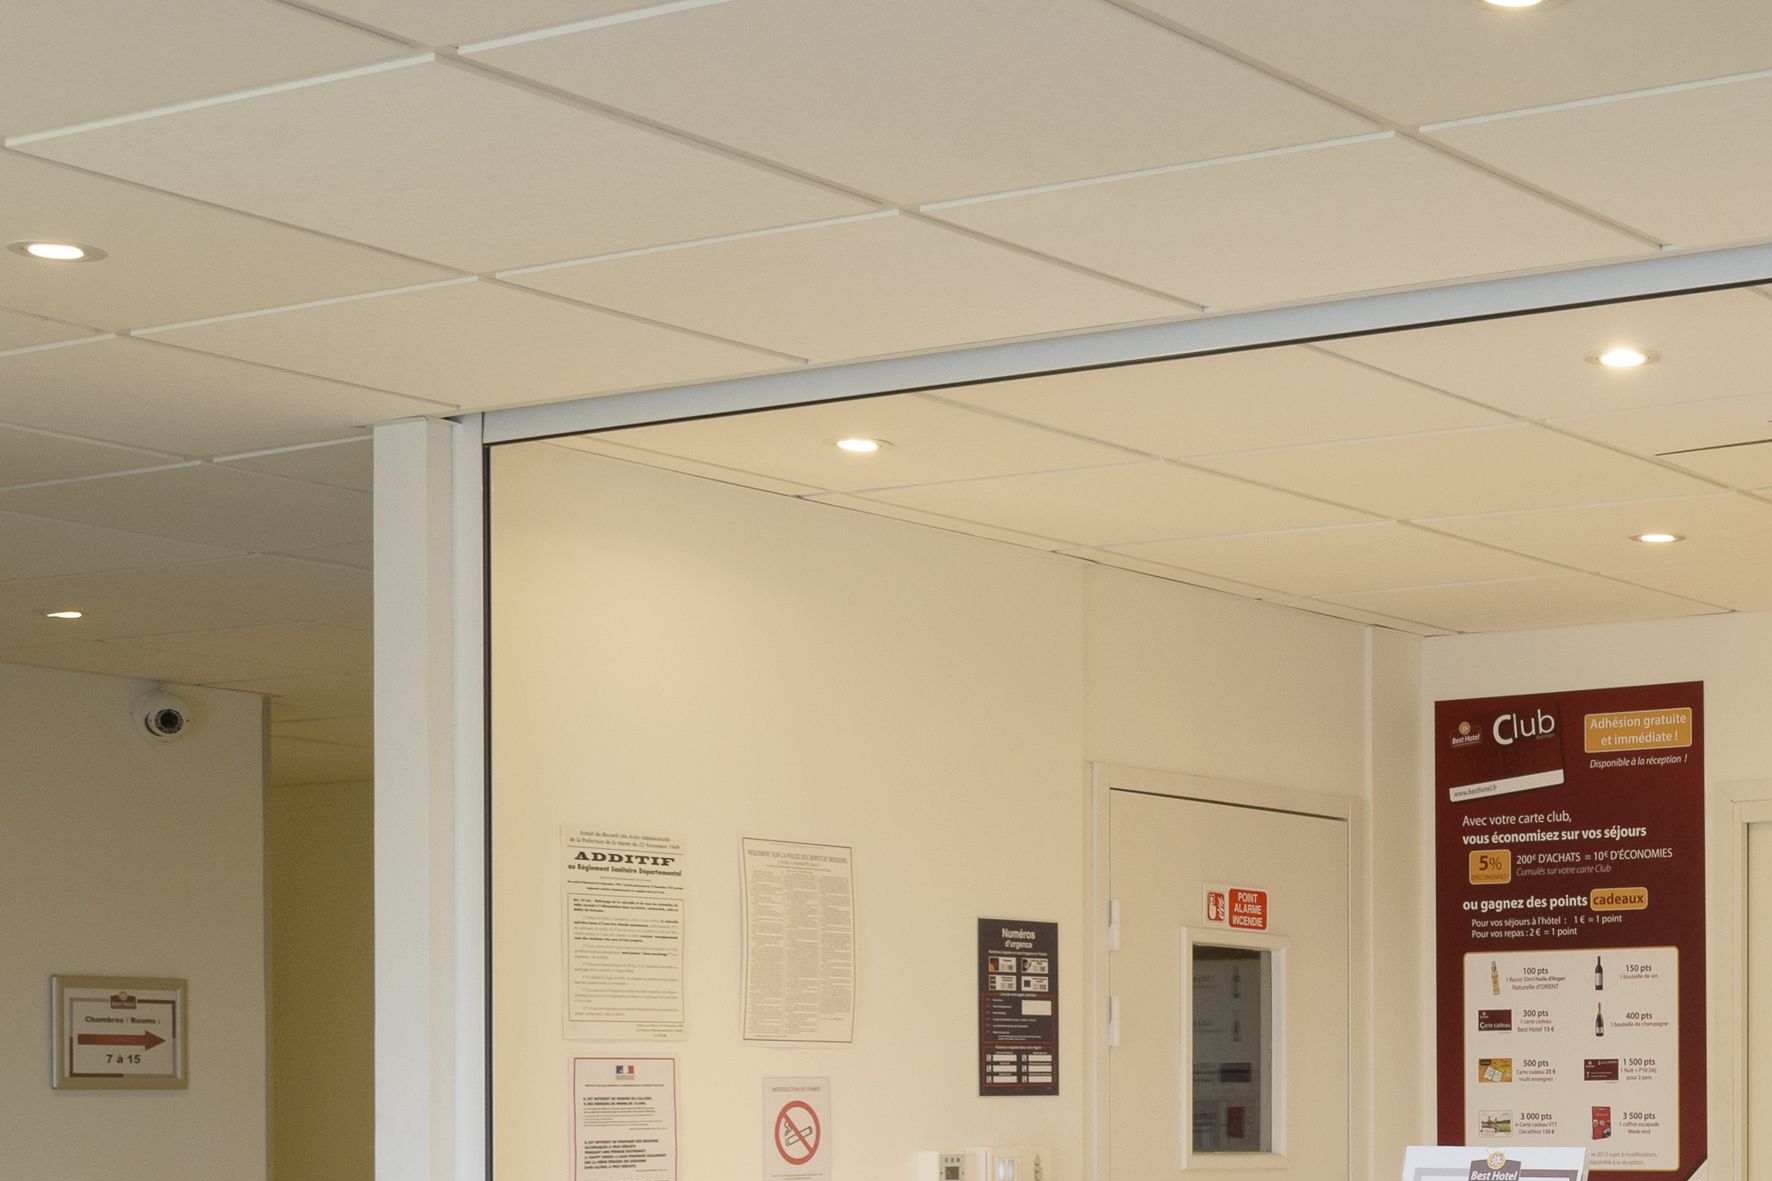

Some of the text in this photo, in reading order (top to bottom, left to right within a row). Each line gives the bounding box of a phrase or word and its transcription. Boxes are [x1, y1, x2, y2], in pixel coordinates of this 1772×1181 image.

[1493, 709, 1555, 745] Club
[1590, 713, 1687, 730] Adhésion gratuite
[1465, 734, 1480, 742] Hotel
[1600, 732, 1672, 745] et immédiate
[1589, 755, 1681, 769] Disponible à la réception
[1462, 811, 1572, 826] Avec votre carte club,
[1463, 826, 1647, 845] vous économisez sur vos séjours
[575, 851, 675, 866] ADDITIF
[1517, 854, 1536, 865] 200€
[1538, 852, 1581, 863] D'ACHATS
[1610, 848, 1673, 860] D'ÉCONOMIES
[1479, 856, 1502, 871] 5%
[1238, 892, 1257, 902] POINT
[1463, 892, 1644, 912] ou gagnez des points cadeaux
[1234, 903, 1261, 914] ALARME
[1232, 915, 1263, 927] INCENDIE
[1472, 914, 1622, 927] Pour vos séjours à l'hôtel point
[1002, 928, 1035, 939] Numéros
[1472, 927, 1577, 939] Pour vos repas point
[1005, 940, 1032, 949] d'urgence
[1538, 1009, 1549, 1018] pts
[1641, 1012, 1652, 1020] pts
[106, 1054, 113, 1063] 7
[128, 1055, 141, 1063] 15
[1538, 1059, 1549, 1067] pts
[1644, 1058, 1655, 1067] pts
[1541, 1112, 1552, 1121] pts
[1644, 1112, 1656, 1120] pts
[1471, 1171, 1518, 1181] Best Hotel
